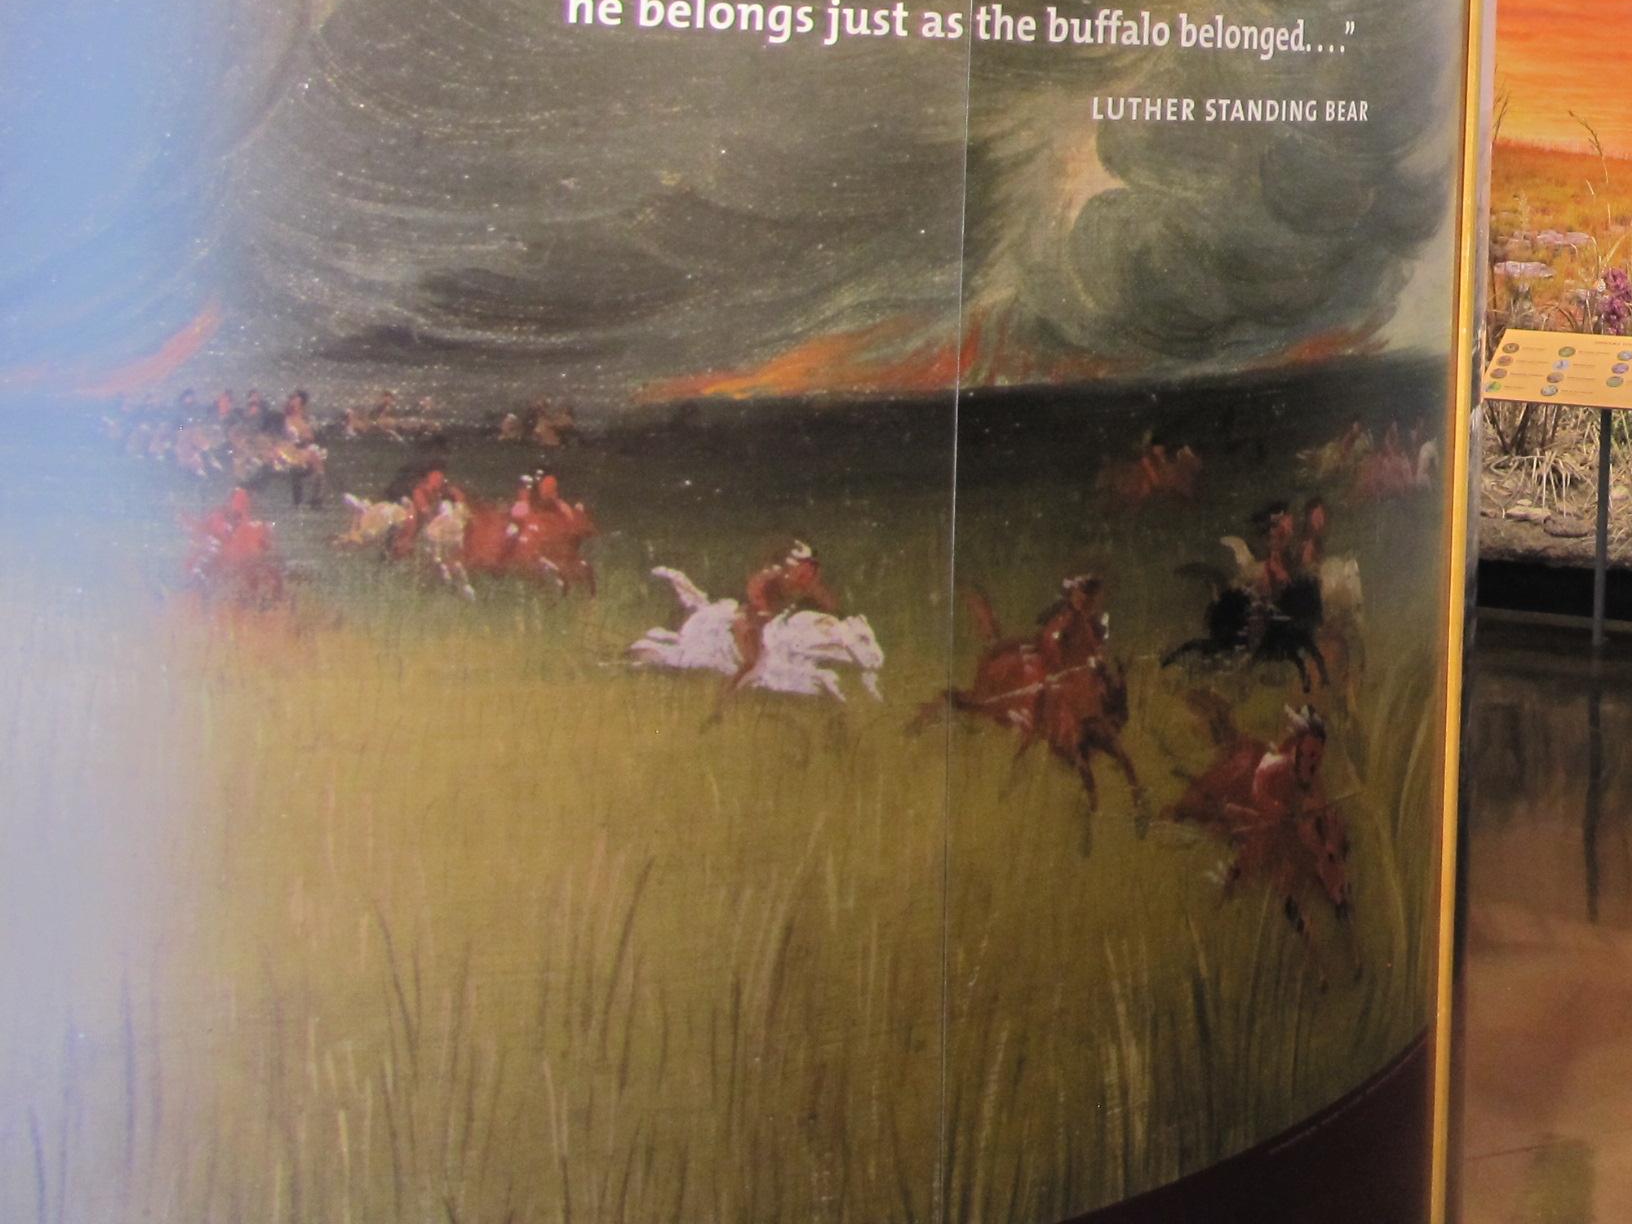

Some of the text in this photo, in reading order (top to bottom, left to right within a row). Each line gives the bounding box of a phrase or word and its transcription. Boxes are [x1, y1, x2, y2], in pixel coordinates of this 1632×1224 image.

[922, 12, 963, 38] as
[976, 4, 1036, 41] the
[1046, 7, 1170, 46] buffalo
[1093, 97, 1367, 121] LUTHER STANDING BEAR
